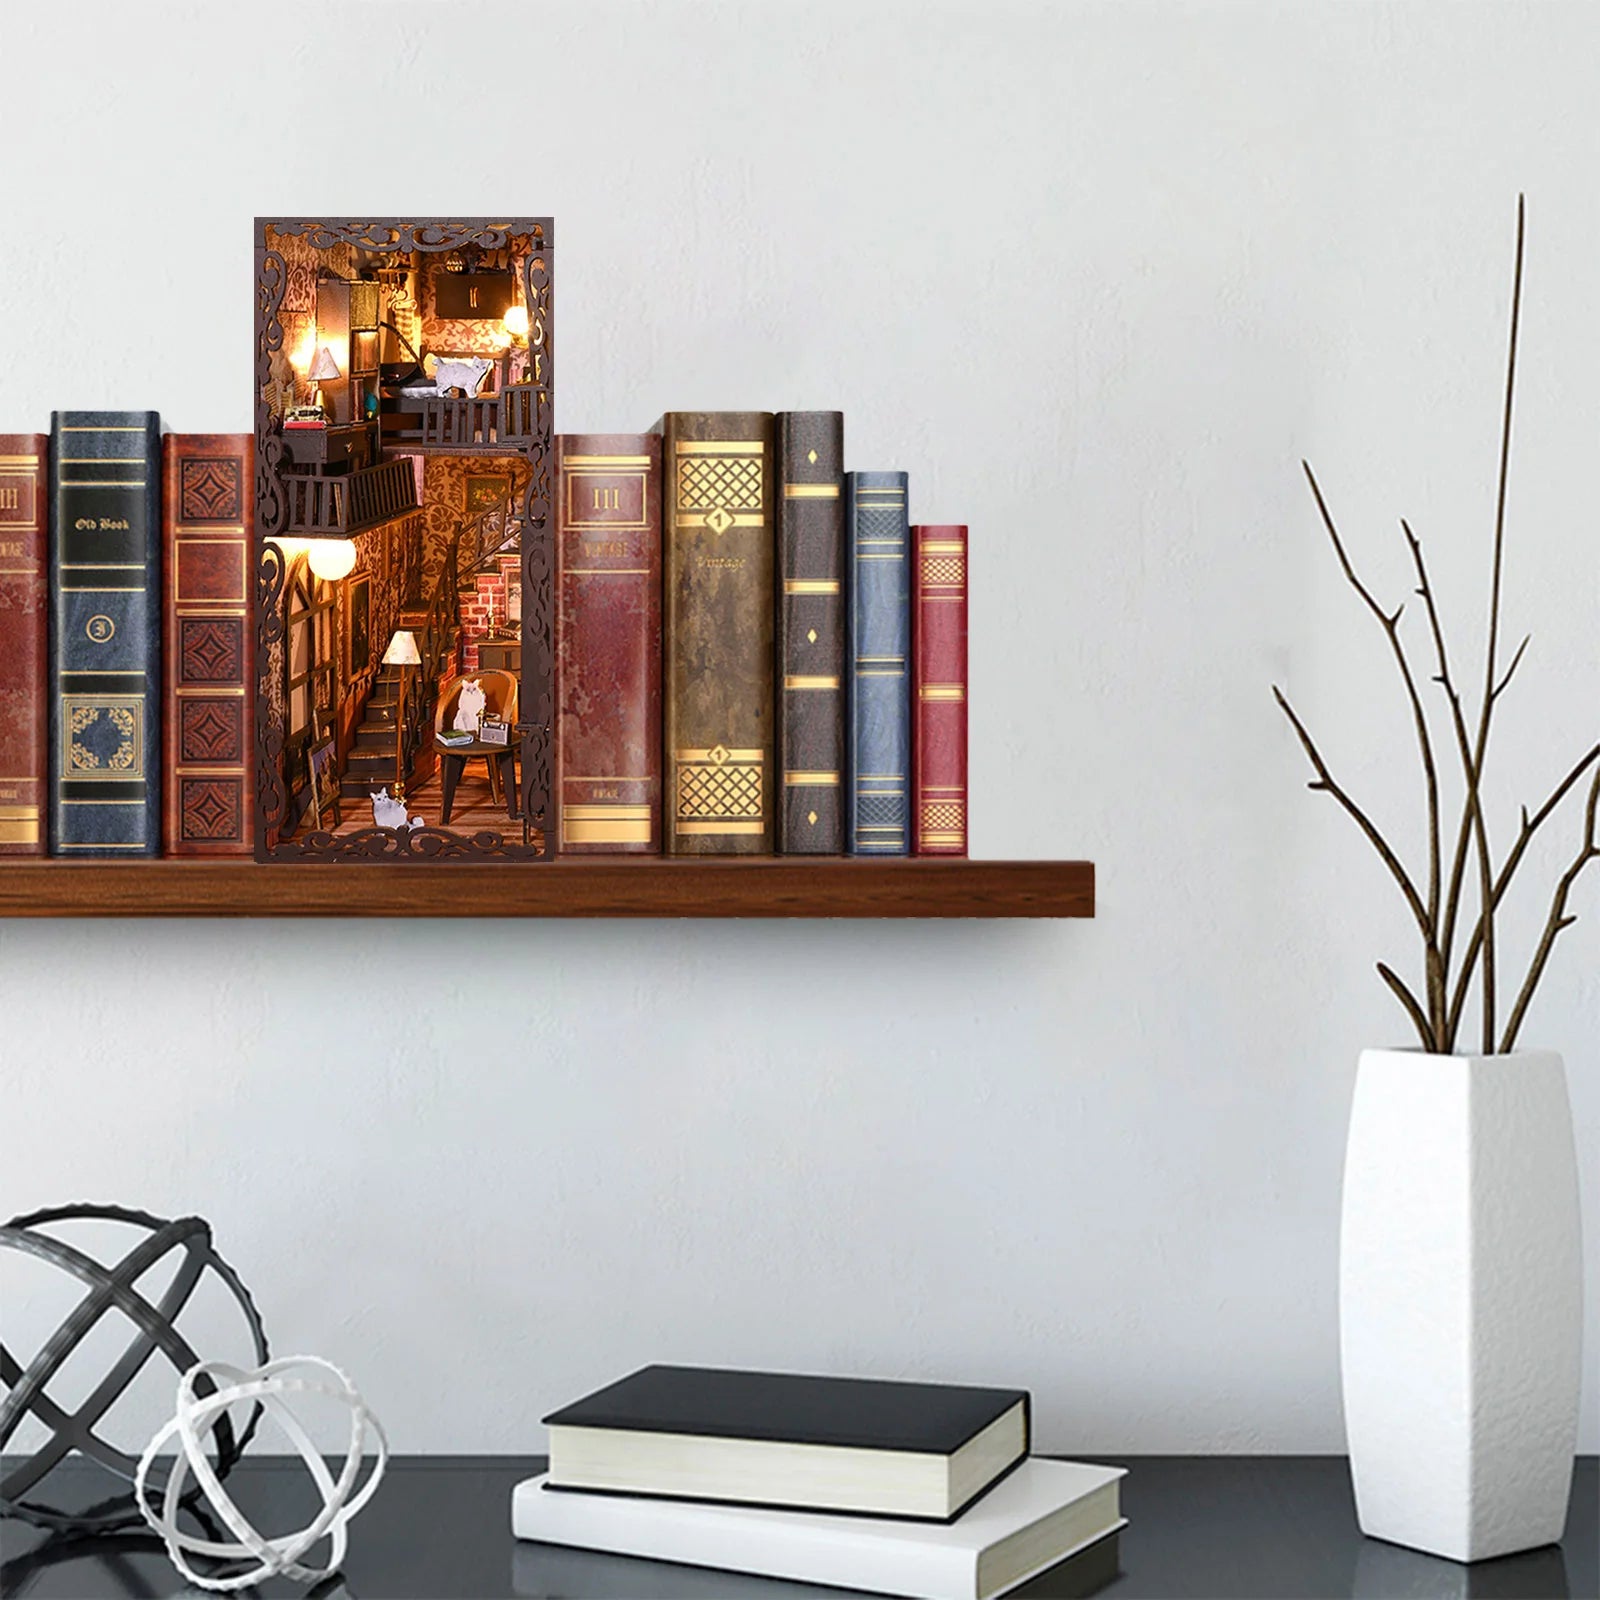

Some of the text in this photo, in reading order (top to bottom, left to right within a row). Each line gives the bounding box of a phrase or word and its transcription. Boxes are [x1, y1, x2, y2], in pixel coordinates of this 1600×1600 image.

[593, 488, 620, 510] III
[75, 518, 130, 532] Old Book
[714, 513, 722, 527] 1
[696, 555, 747, 573] Vintage
[714, 749, 722, 761] 1
